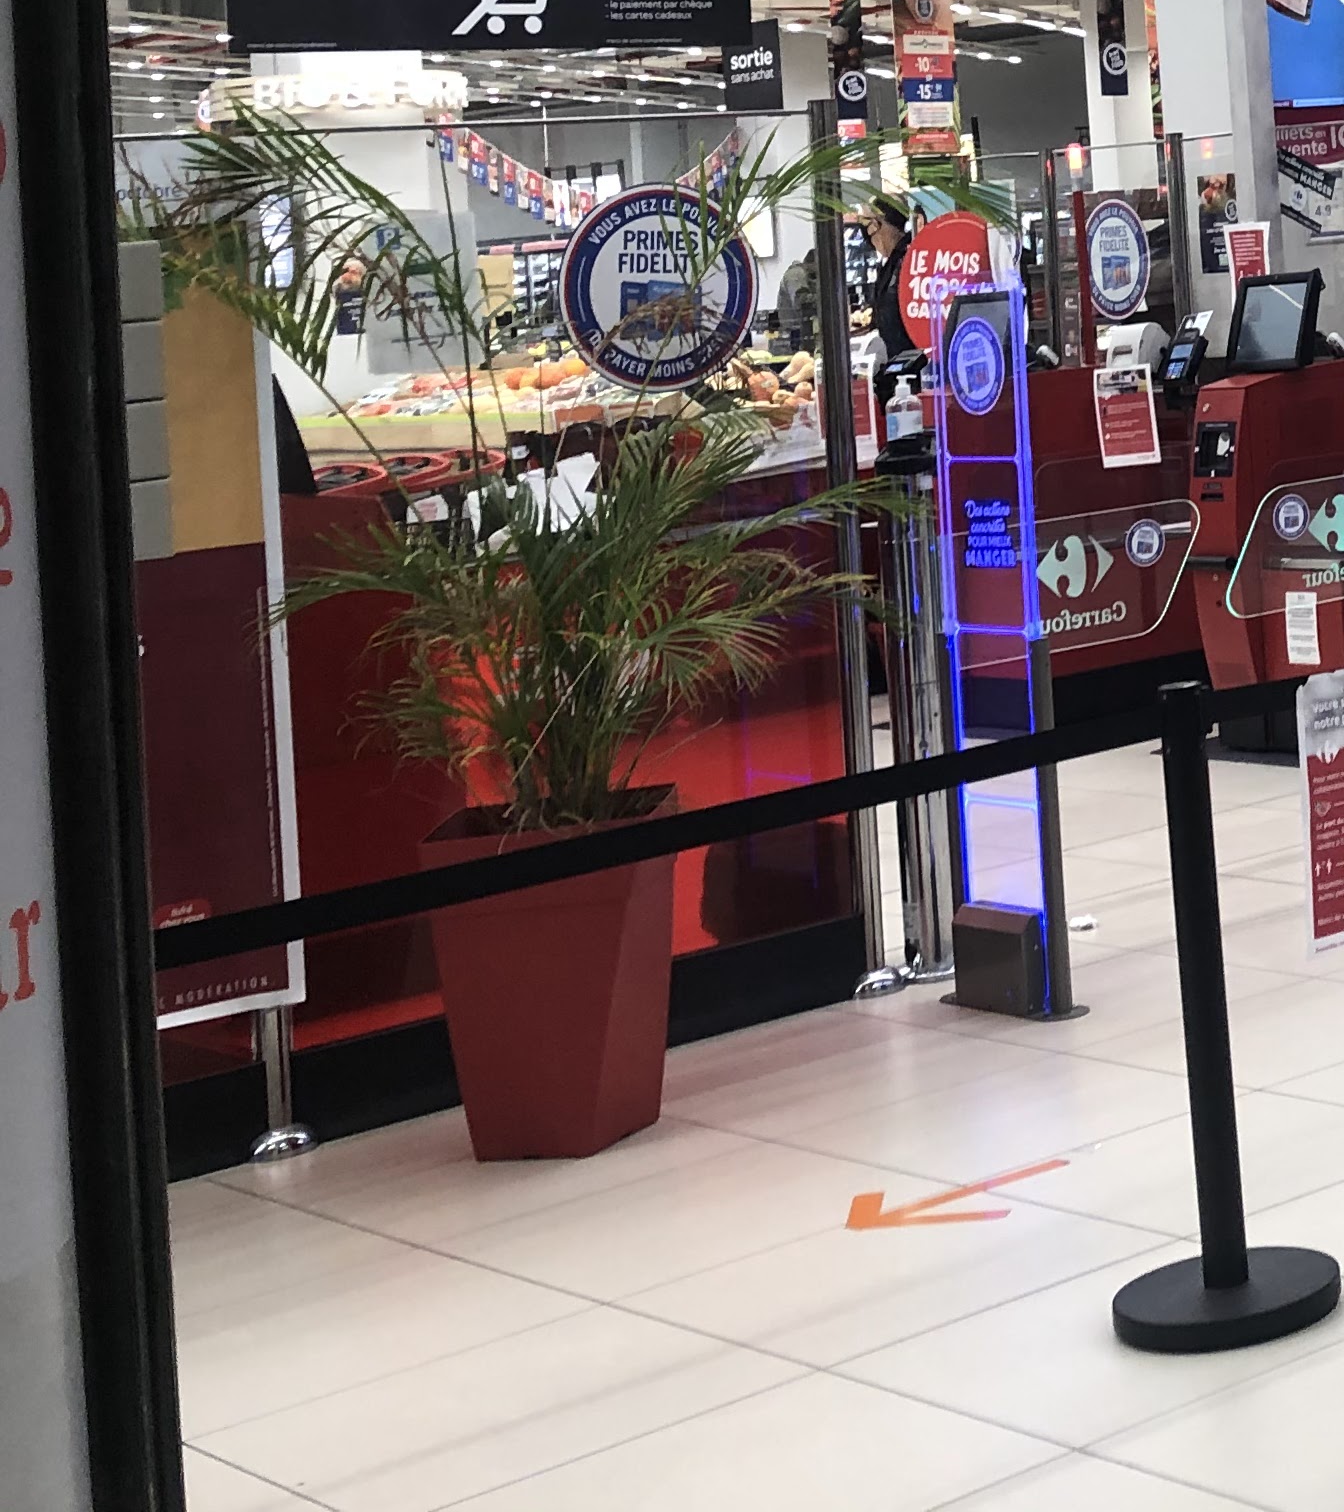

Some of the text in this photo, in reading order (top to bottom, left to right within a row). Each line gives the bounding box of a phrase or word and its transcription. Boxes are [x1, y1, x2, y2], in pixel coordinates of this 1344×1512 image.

[730, 47, 773, 70] sortie
[730, 68, 774, 84] sans achat
[588, 212, 622, 245] VOUS
[624, 198, 657, 218] AVEZ
[623, 230, 699, 251] PRIMES
[908, 249, 981, 275] LE MOIS
[650, 357, 696, 378] MOINS
[1314, 713, 1341, 730] notre
